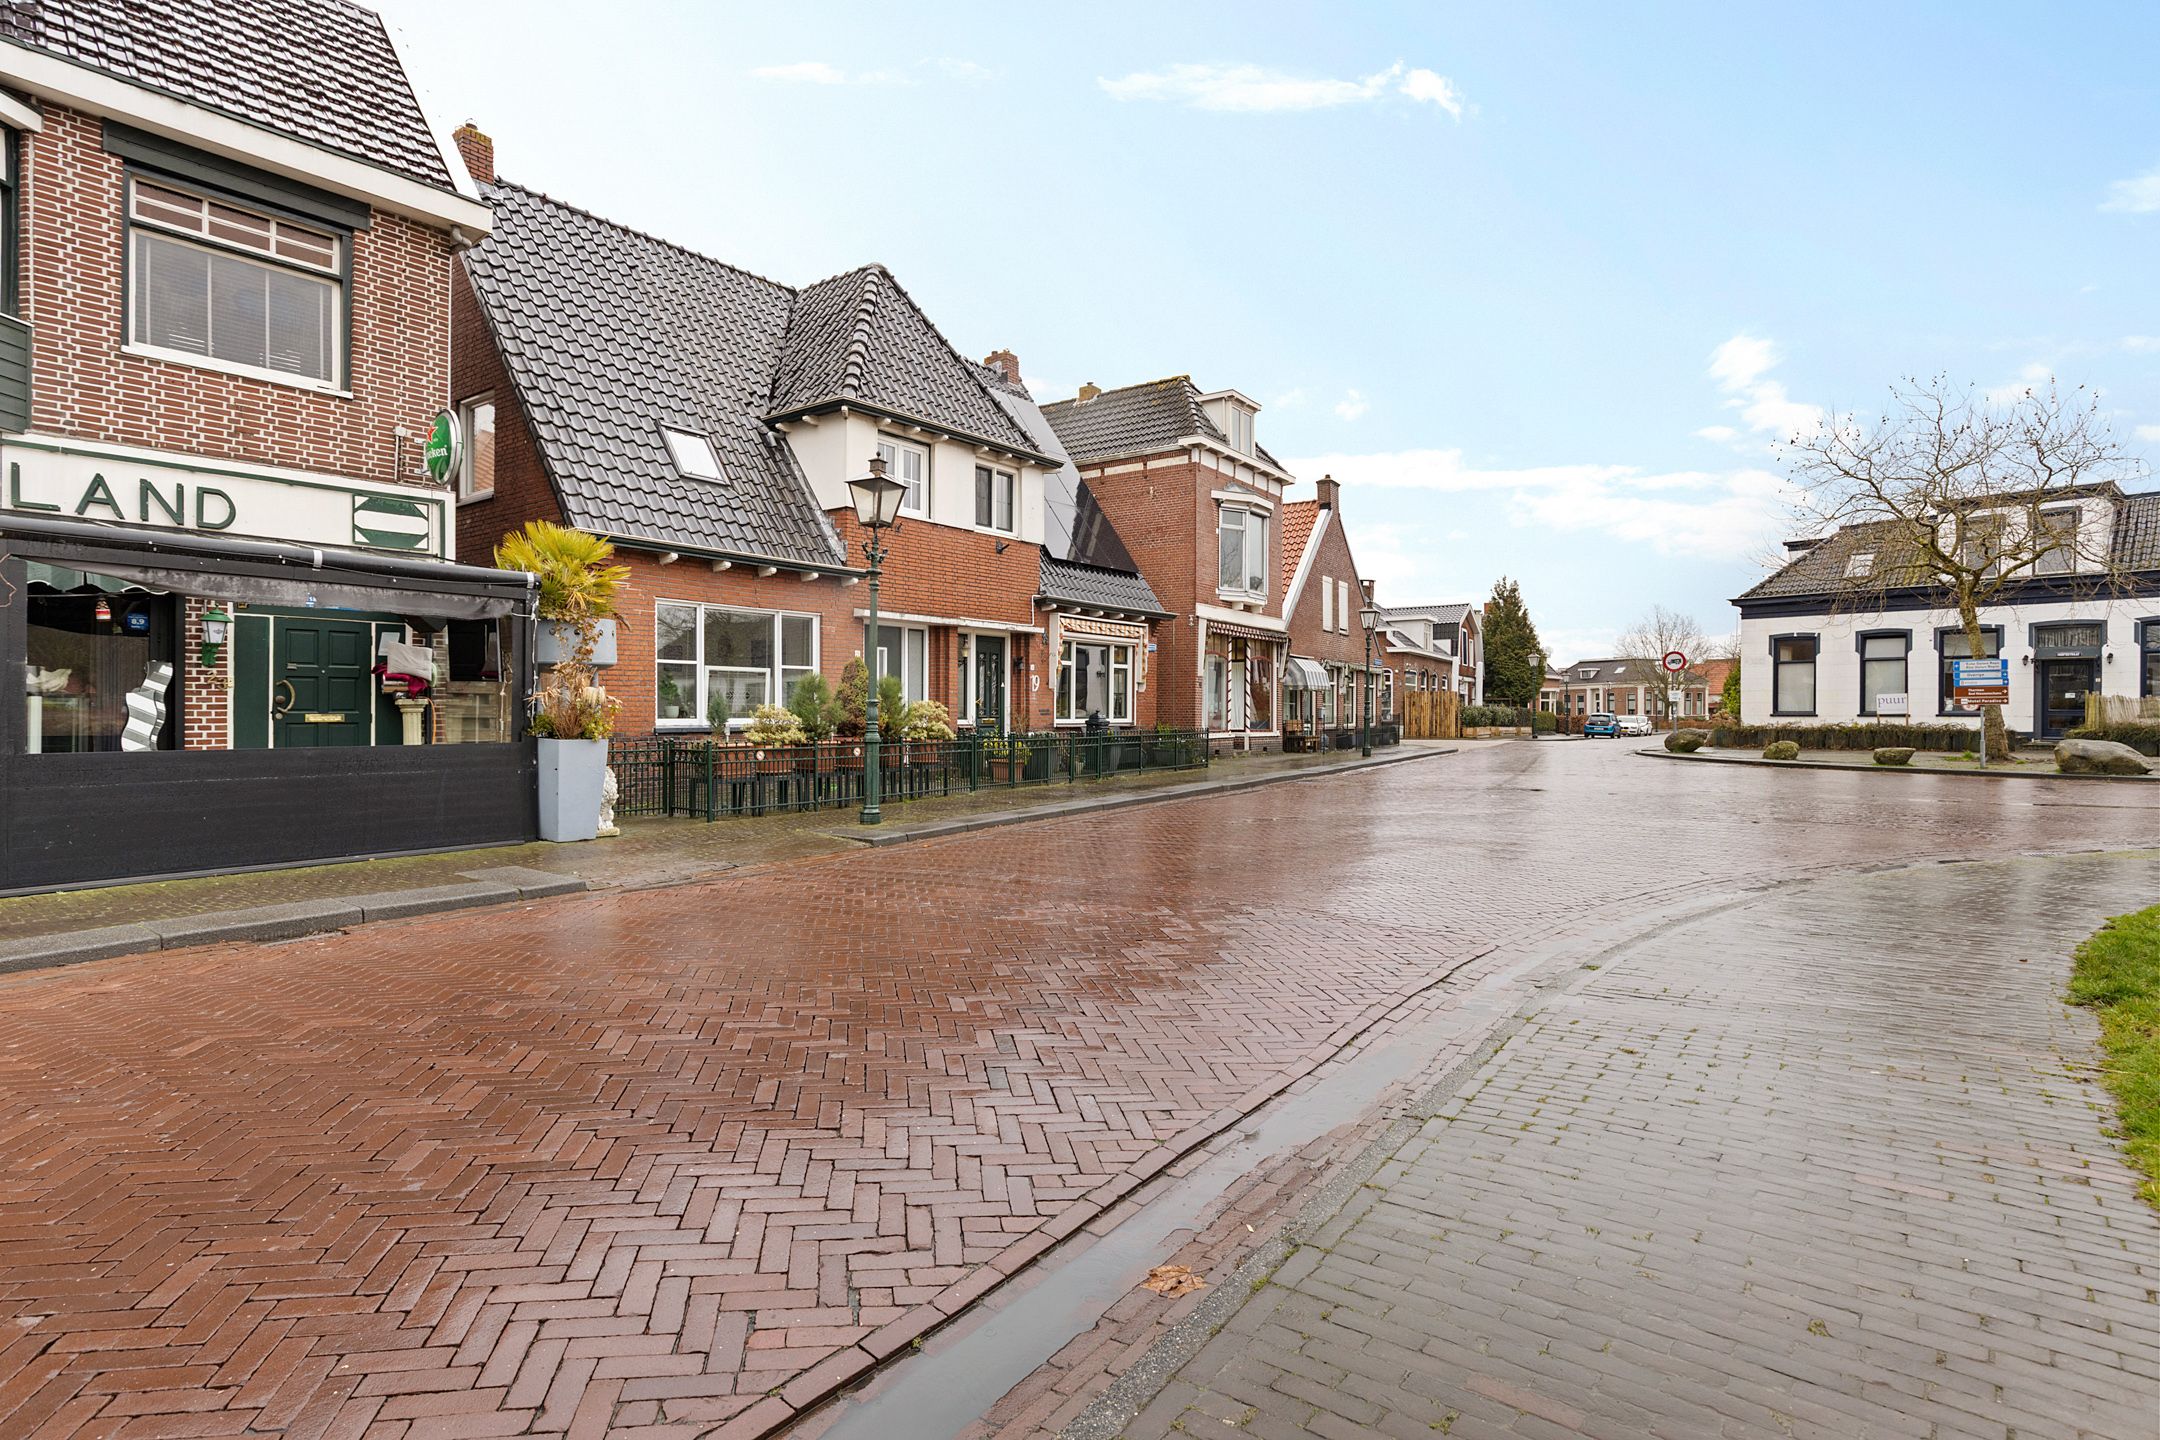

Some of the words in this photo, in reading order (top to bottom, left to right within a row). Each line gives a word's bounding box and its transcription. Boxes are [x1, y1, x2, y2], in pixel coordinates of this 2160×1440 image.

[11, 462, 237, 530] LAND
[1030, 674, 1040, 692] 19
[1878, 697, 1906, 708] puur
